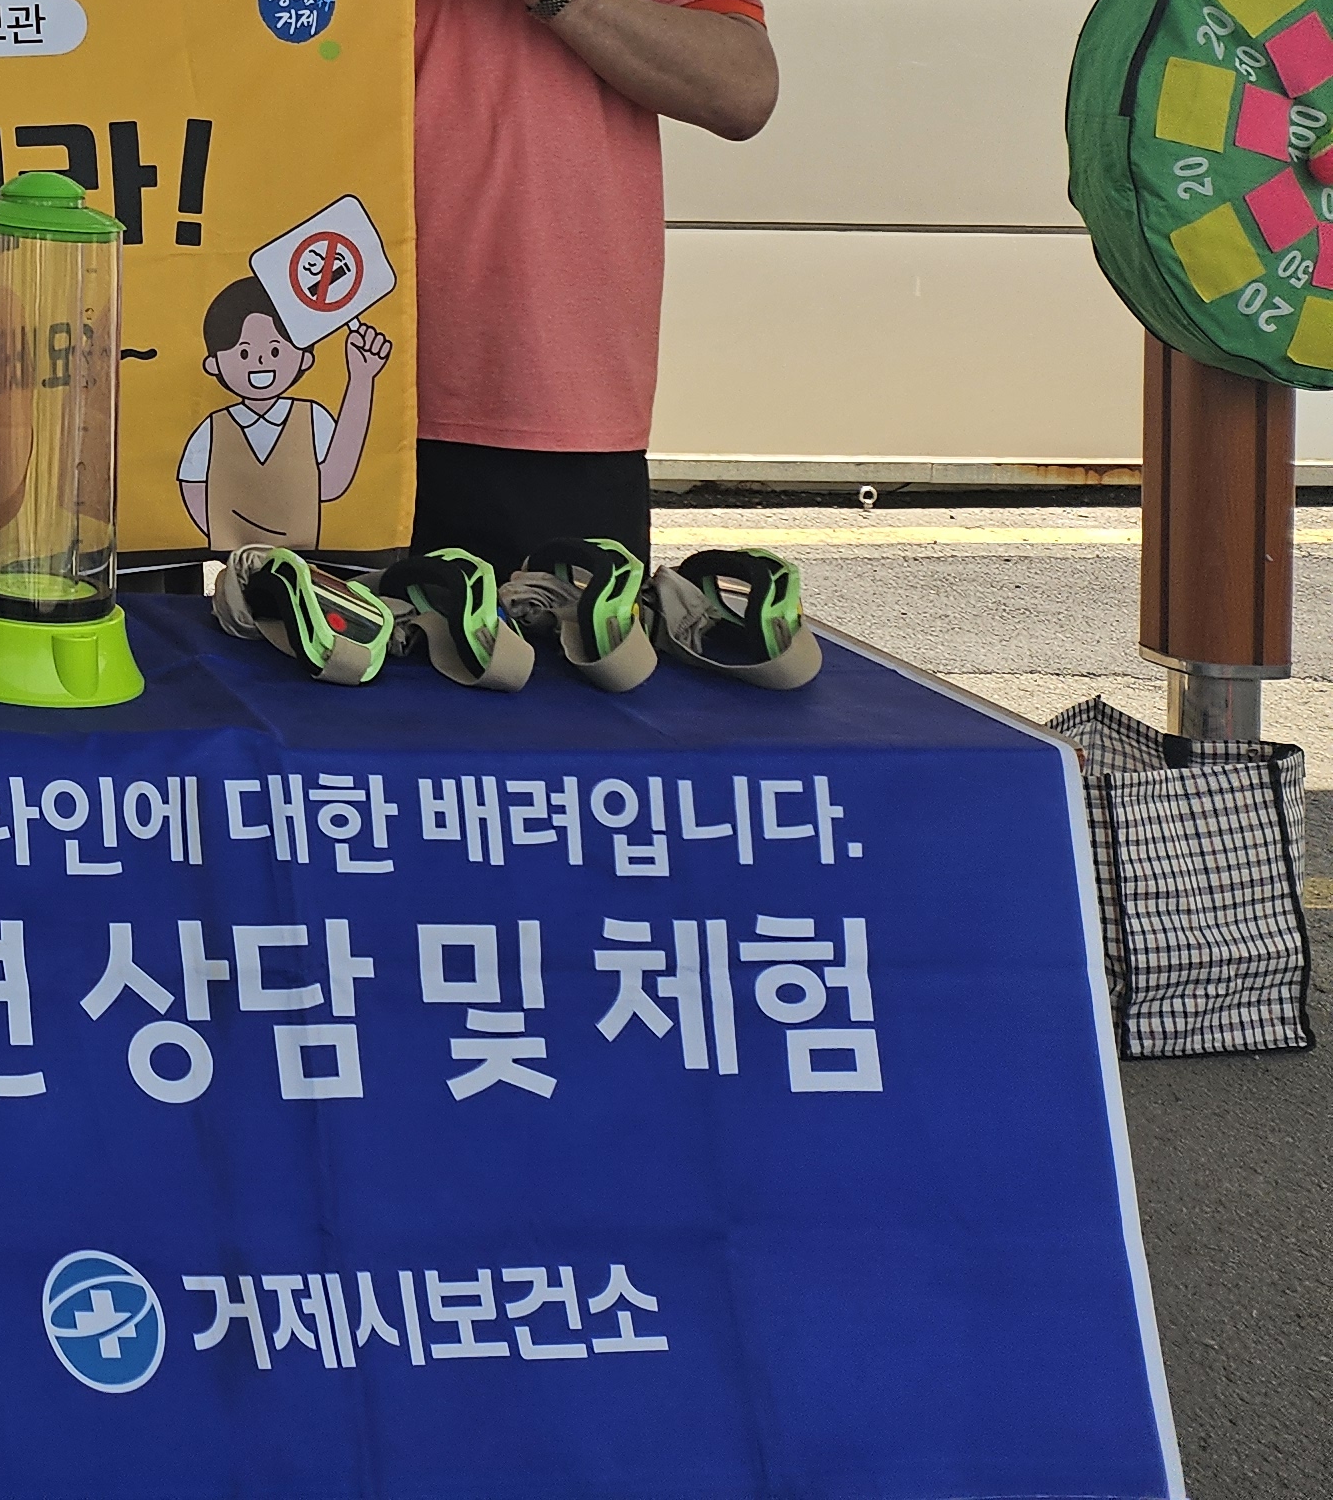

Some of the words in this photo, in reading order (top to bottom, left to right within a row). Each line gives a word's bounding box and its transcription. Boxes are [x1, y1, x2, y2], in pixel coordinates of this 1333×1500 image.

[275, 9, 318, 35] 거제
[1197, 6, 1235, 61] 20
[1235, 46, 1267, 82] 50
[1173, 156, 1214, 200] 20
[1278, 251, 1314, 288] 50
[1237, 282, 1295, 333] 20
[226, 773, 399, 875] 대한
[419, 774, 866, 878] 배려입니다.
[79, 917, 376, 1104] 상담
[416, 918, 559, 1102] 및
[593, 913, 885, 1095] 체험
[181, 1263, 671, 1369] 거제시보건소
